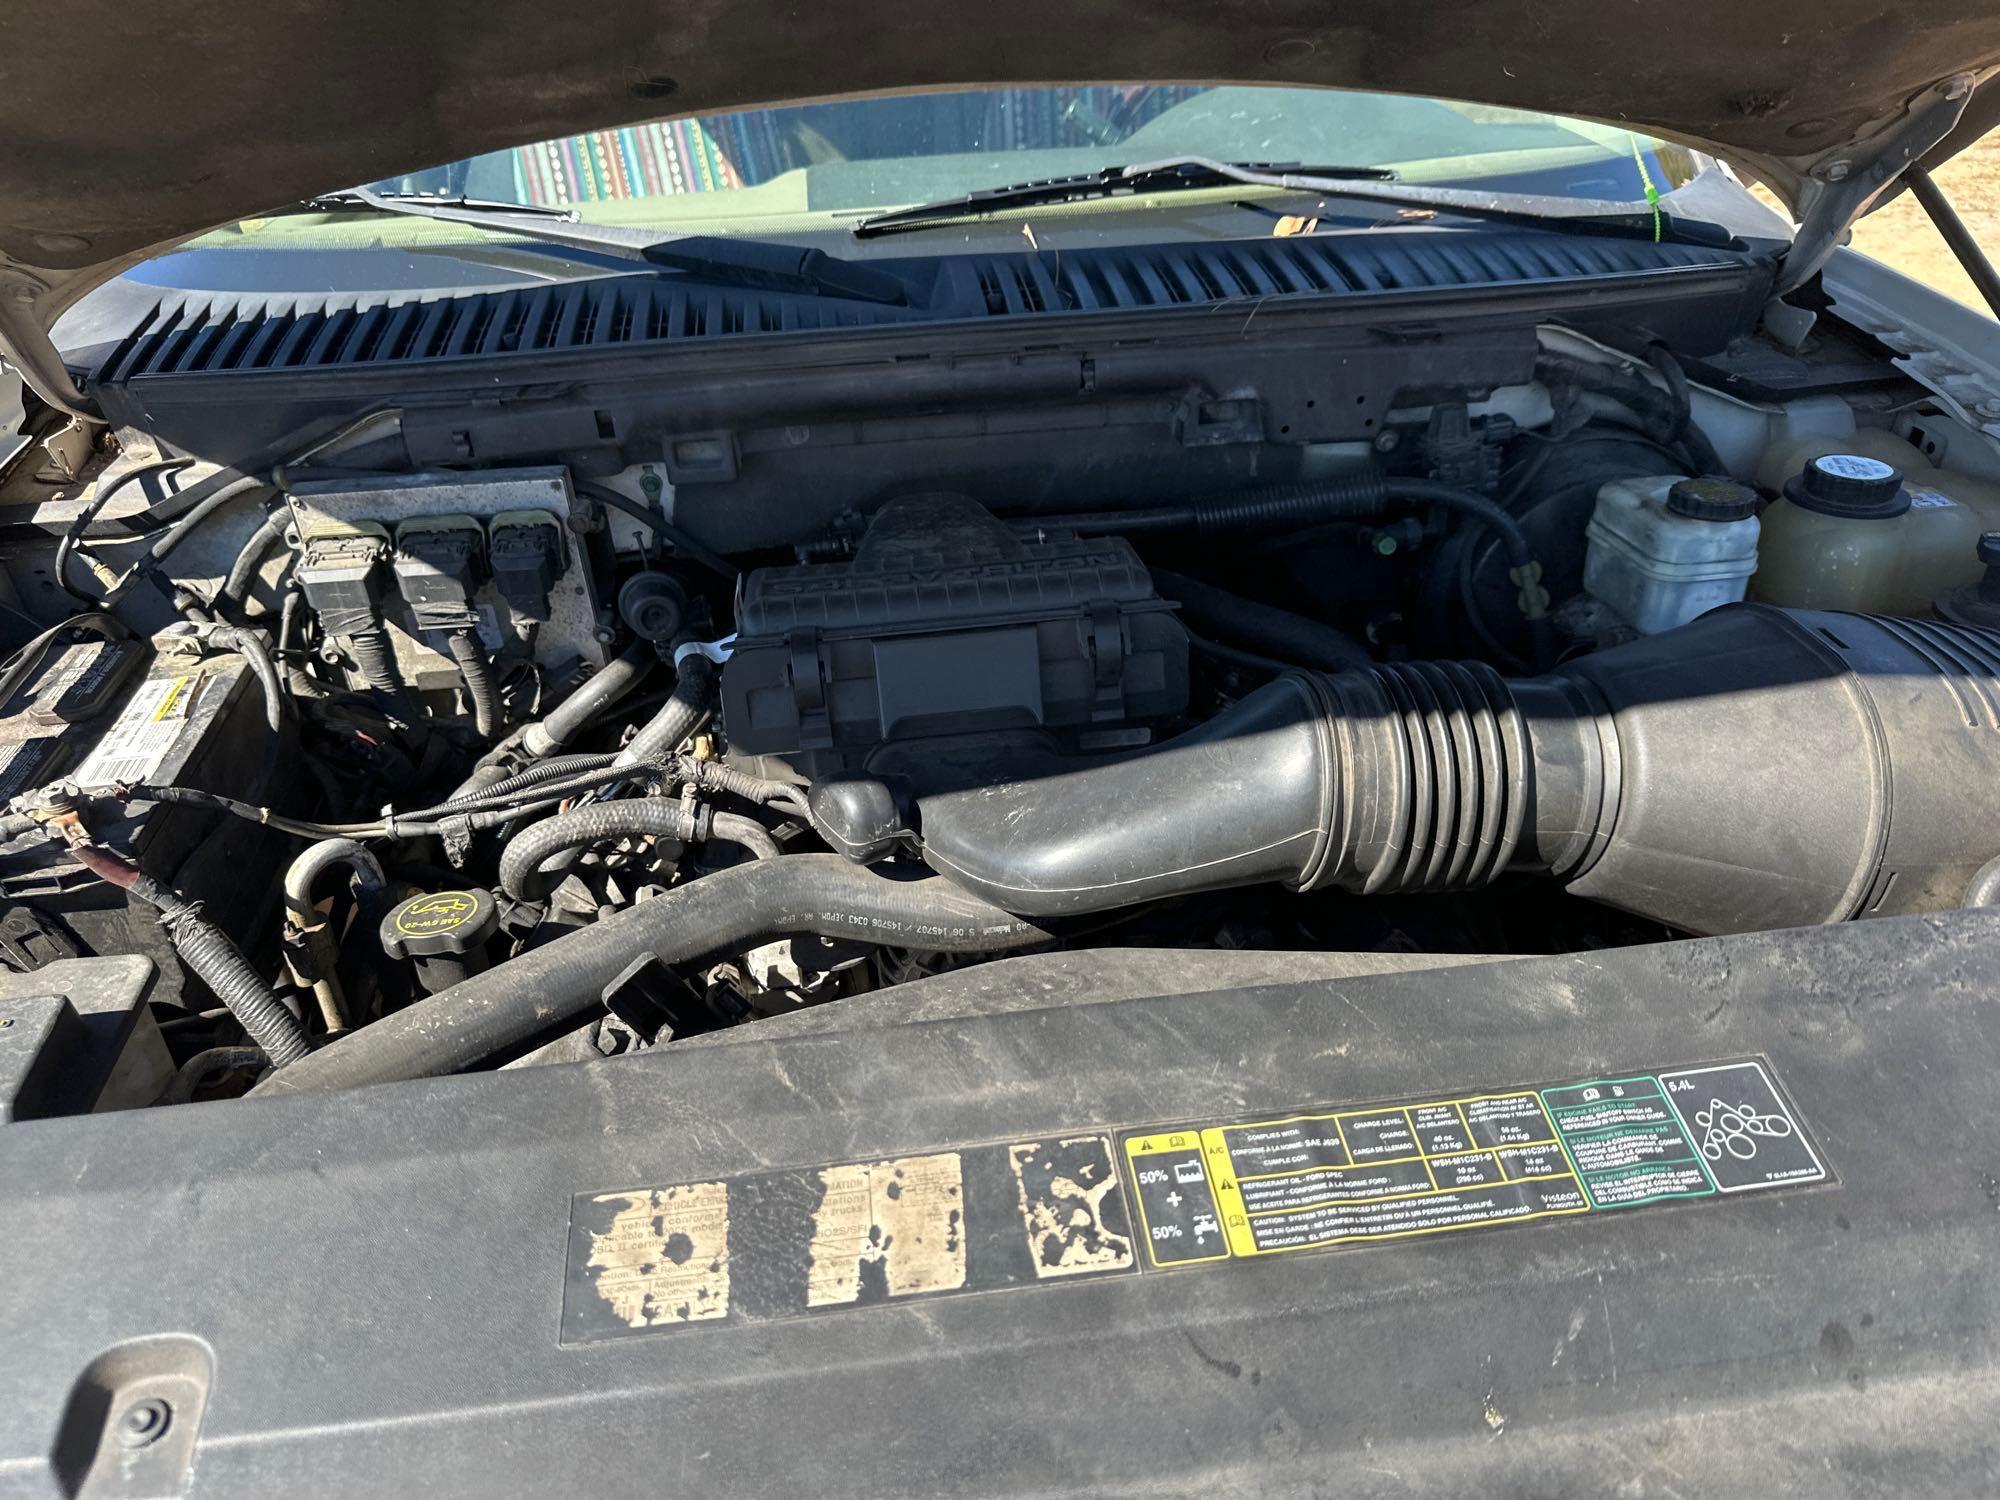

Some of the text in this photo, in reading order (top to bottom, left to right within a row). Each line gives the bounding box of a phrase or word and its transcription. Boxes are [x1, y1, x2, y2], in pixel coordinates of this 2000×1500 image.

[440, 917, 461, 925] SAE
[848, 914, 868, 926] 0343
[871, 918, 902, 931] 145706
[916, 925, 948, 935] 145707
[1668, 1079, 1695, 1092] 5.4L
[1469, 1106, 1509, 1116] CLIMATISATION
[1470, 1101, 1489, 1109] FRONT
[1588, 1105, 1608, 1113] FAILS
[1478, 1113, 1510, 1122] DELANTERO
[1515, 1109, 1541, 1117] TRASERO
[1559, 1116, 1580, 1124] CHECK
[1594, 1109, 1622, 1119] SHUTOFF
[1353, 1118, 1404, 1129] CHARGE LEVEL:
[1426, 1119, 1460, 1128] DELANTERO
[1562, 1120, 1601, 1130] REFERENCED
[1608, 1115, 1626, 1123] YOUR
[1247, 1129, 1300, 1141] COMPLIES WITH:
[1379, 1130, 1409, 1139] CHARGE:
[1586, 1133, 1615, 1142] MOTEUR
[1612, 1134, 1648, 1145] COMMANDE
[1231, 1147, 1265, 1156] CONFORME
[1304, 1139, 1321, 1147] SAE
[1322, 1138, 1340, 1146] J639
[1353, 1147, 1375, 1155] CARGA
[1575, 1147, 1607, 1157] COUPURE
[1658, 1137, 1683, 1146] COMME
[1604, 1150, 1625, 1159] DANS
[1635, 1146, 1654, 1154] GUIDE
[1263, 1157, 1291, 1166] CUMPLE
[1139, 1170, 1168, 1184] 50%
[1243, 1178, 1288, 1189] REFRIGERANT
[1305, 1172, 1325, 1182] FORD
[1591, 1181, 1614, 1189] REVISE
[1622, 1172, 1668, 1185] INTERRUPTOR
[1676, 1169, 1699, 1178] CIERRE
[1246, 1189, 1284, 1200] LUBRIFIANT
[1289, 1182, 1327, 1194] CONFORME
[1344, 1179, 1367, 1187] NORME
[1368, 1177, 1388, 1185] FORD
[1606, 1181, 1654, 1194] COMBUSTIBLE
[1653, 1178, 1672, 1186] COMO
[1681, 1176, 1702, 1184] INDICA
[1262, 1200, 1284, 1208] ACEITE
[1301, 1191, 1350, 1203] REFRIGERANTES
[1350, 1188, 1384, 1197] CONFORME
[1389, 1184, 1412, 1192] NORMA
[1541, 1192, 1580, 1202] Visteon
[1254, 1217, 1285, 1226] CAUTION:
[1288, 1212, 1316, 1222] SYSTEM
[1316, 1209, 1327, 1217] TO
[1338, 1206, 1370, 1214] SERVICED
[1381, 1200, 1417, 1210] QUALIFIED
[1417, 1195, 1459, 1205] PERSONNEL.
[1256, 1228, 1273, 1236] MISE
[1285, 1224, 1309, 1233] GARDE
[1324, 1217, 1354, 1227] CONFIER
[1422, 1205, 1463, 1215] PERSONNEL
[1319, 1228, 1349, 1239] SISTEMA
[1383, 1221, 1417, 1231] ATENDIDO
[1417, 1218, 1436, 1227] SOLO
[1437, 1216, 1452, 1224] POR
[1452, 1212, 1489, 1222] PERSONAL
[1152, 1225, 1182, 1240] 50%
